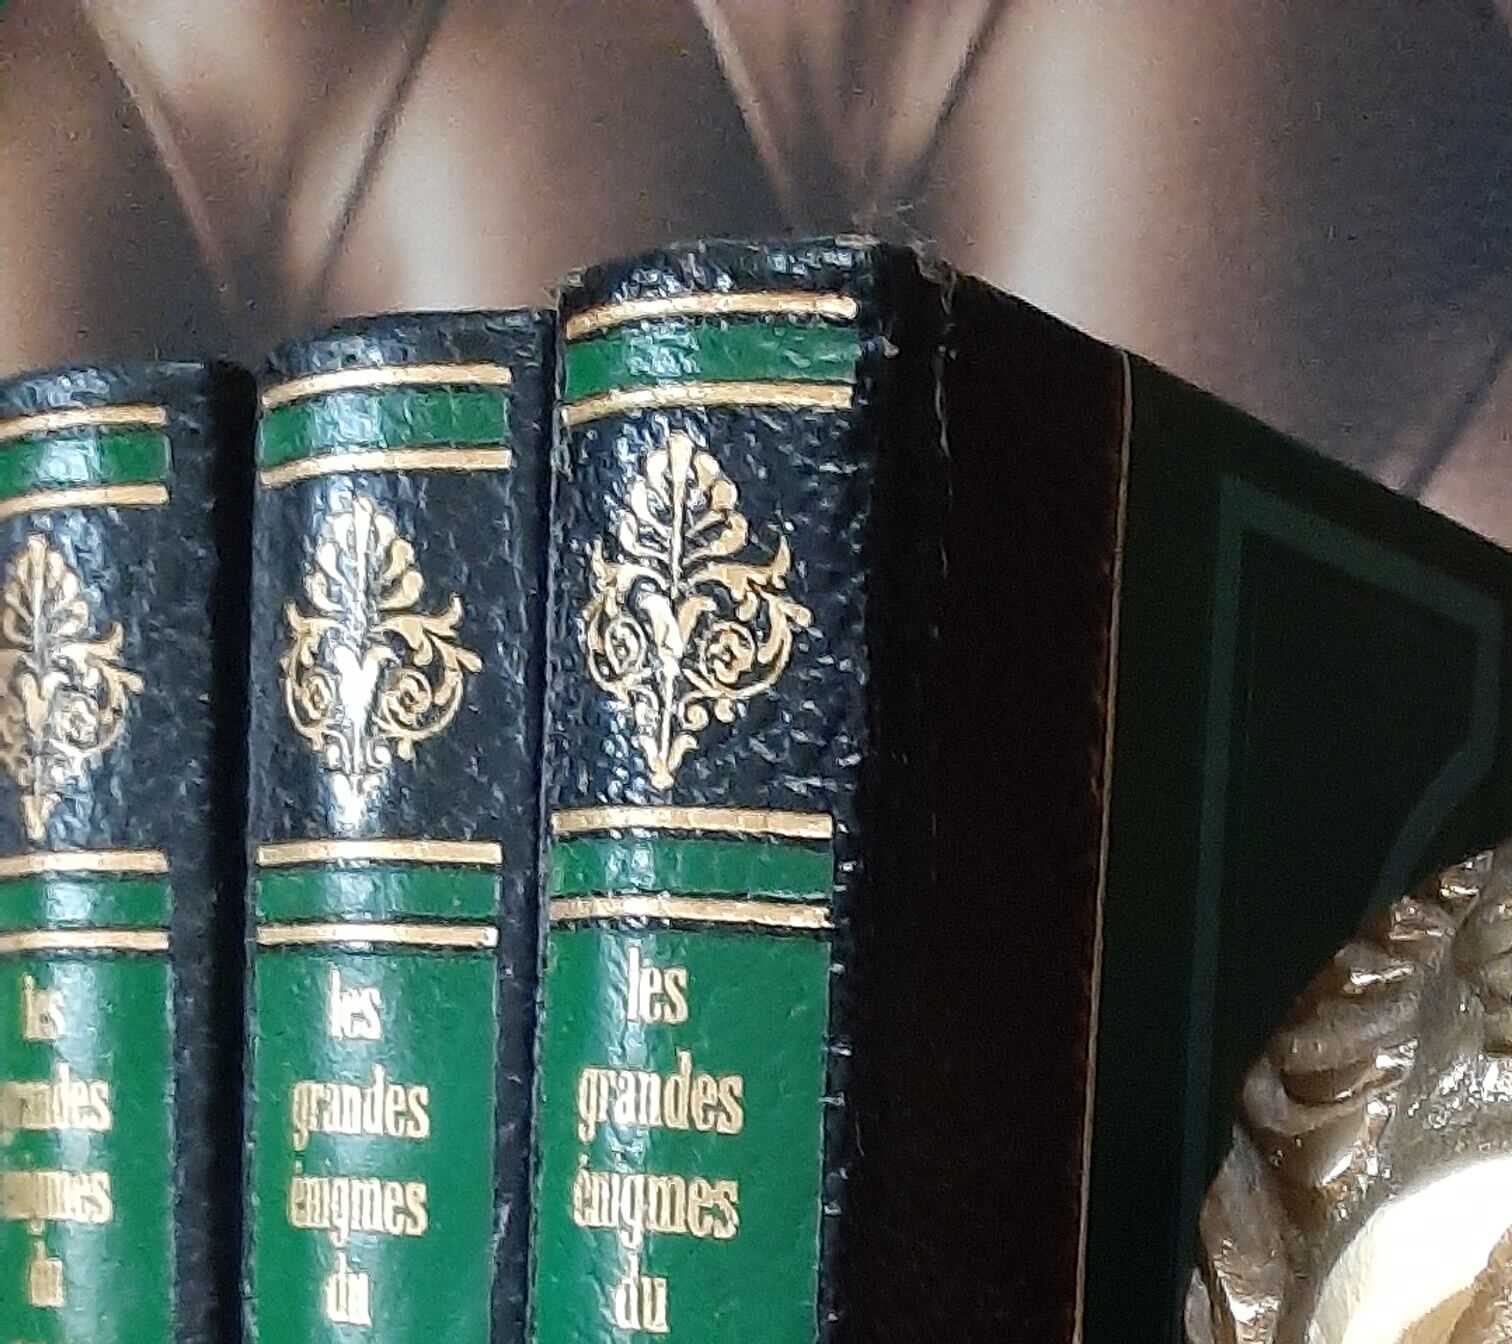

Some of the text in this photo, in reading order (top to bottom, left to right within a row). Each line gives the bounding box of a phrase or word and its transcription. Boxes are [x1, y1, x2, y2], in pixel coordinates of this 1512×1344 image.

[327, 966, 382, 1040] les
[626, 946, 688, 1023] les
[292, 1063, 431, 1151] grandes
[577, 1050, 743, 1143] grandes
[326, 1252, 371, 1325] du
[613, 1253, 670, 1333] du
